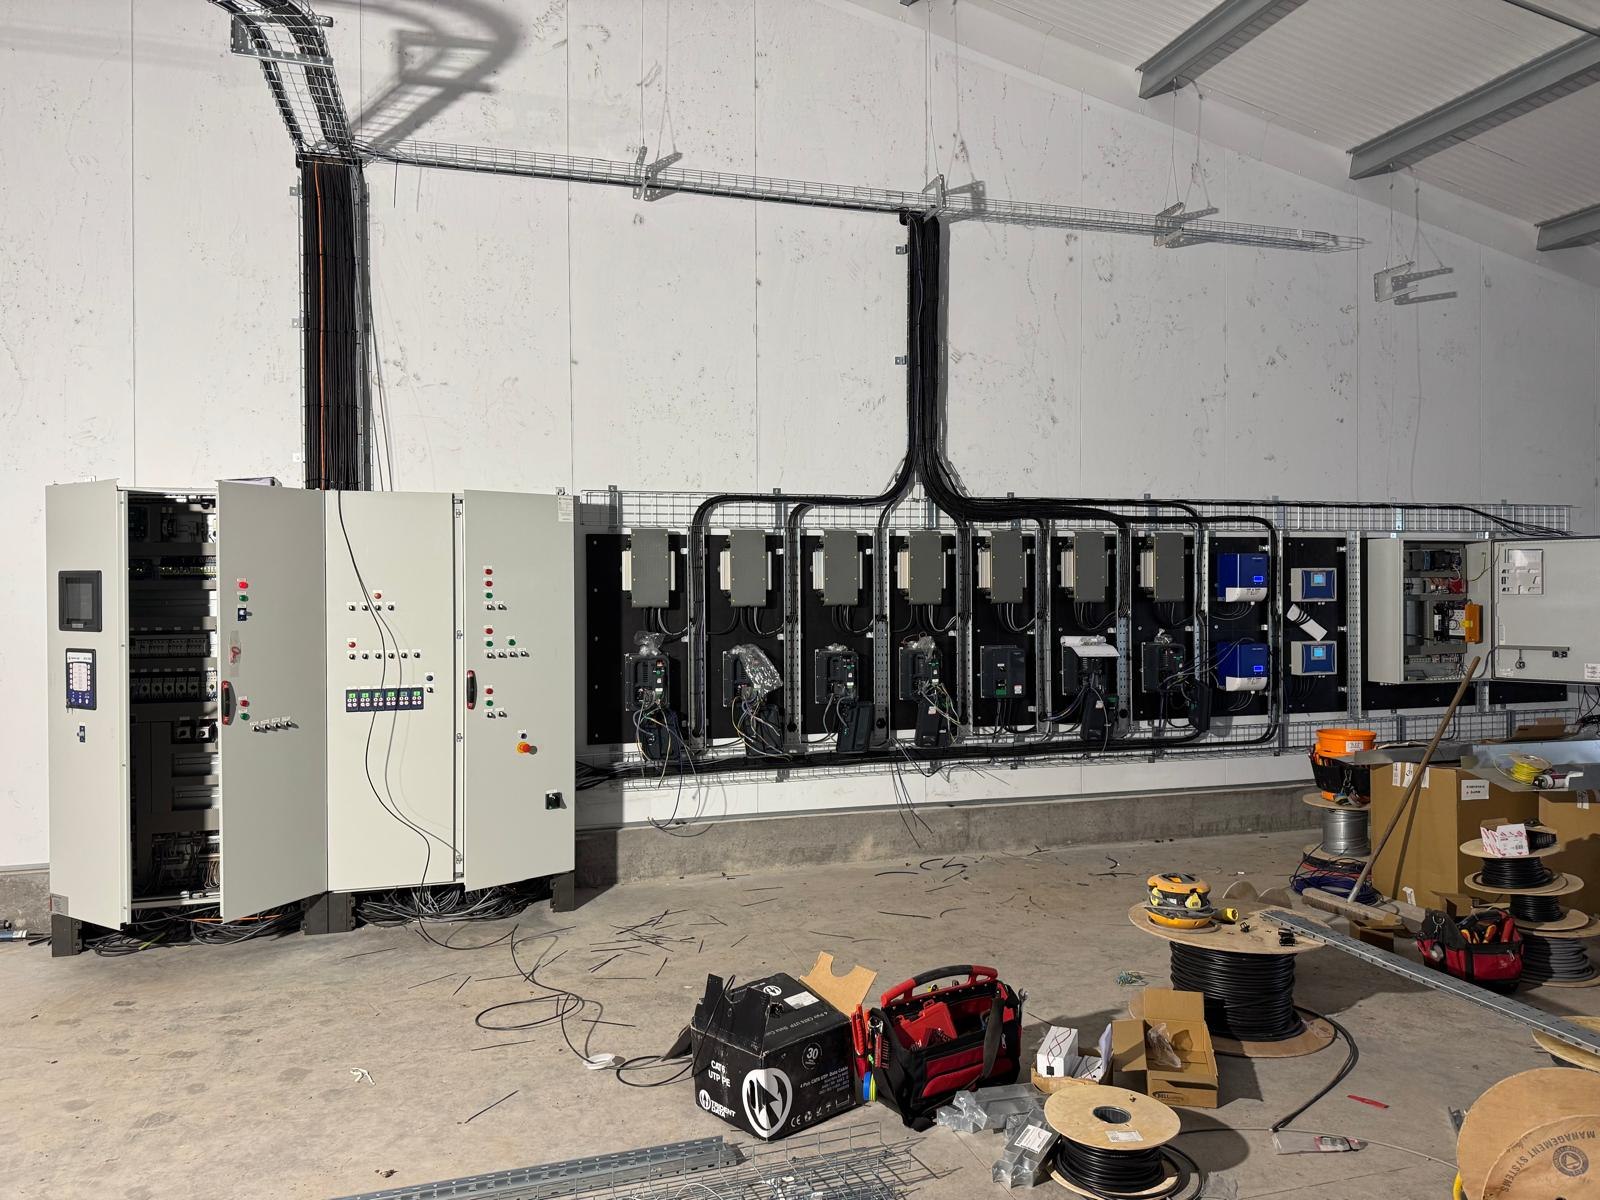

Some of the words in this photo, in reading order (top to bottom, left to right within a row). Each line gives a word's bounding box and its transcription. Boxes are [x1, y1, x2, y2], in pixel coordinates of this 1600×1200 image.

[806, 1047, 819, 1059] 30
[708, 1069, 721, 1082] UTP
[721, 1075, 731, 1088] PE
[710, 1099, 736, 1117] TRIDENT
[711, 1106, 726, 1118] DATA
[790, 1114, 801, 1128] CE
[1527, 1130, 1596, 1158] MANAGEMENT
[1500, 1156, 1529, 1193] SYSTEMS
